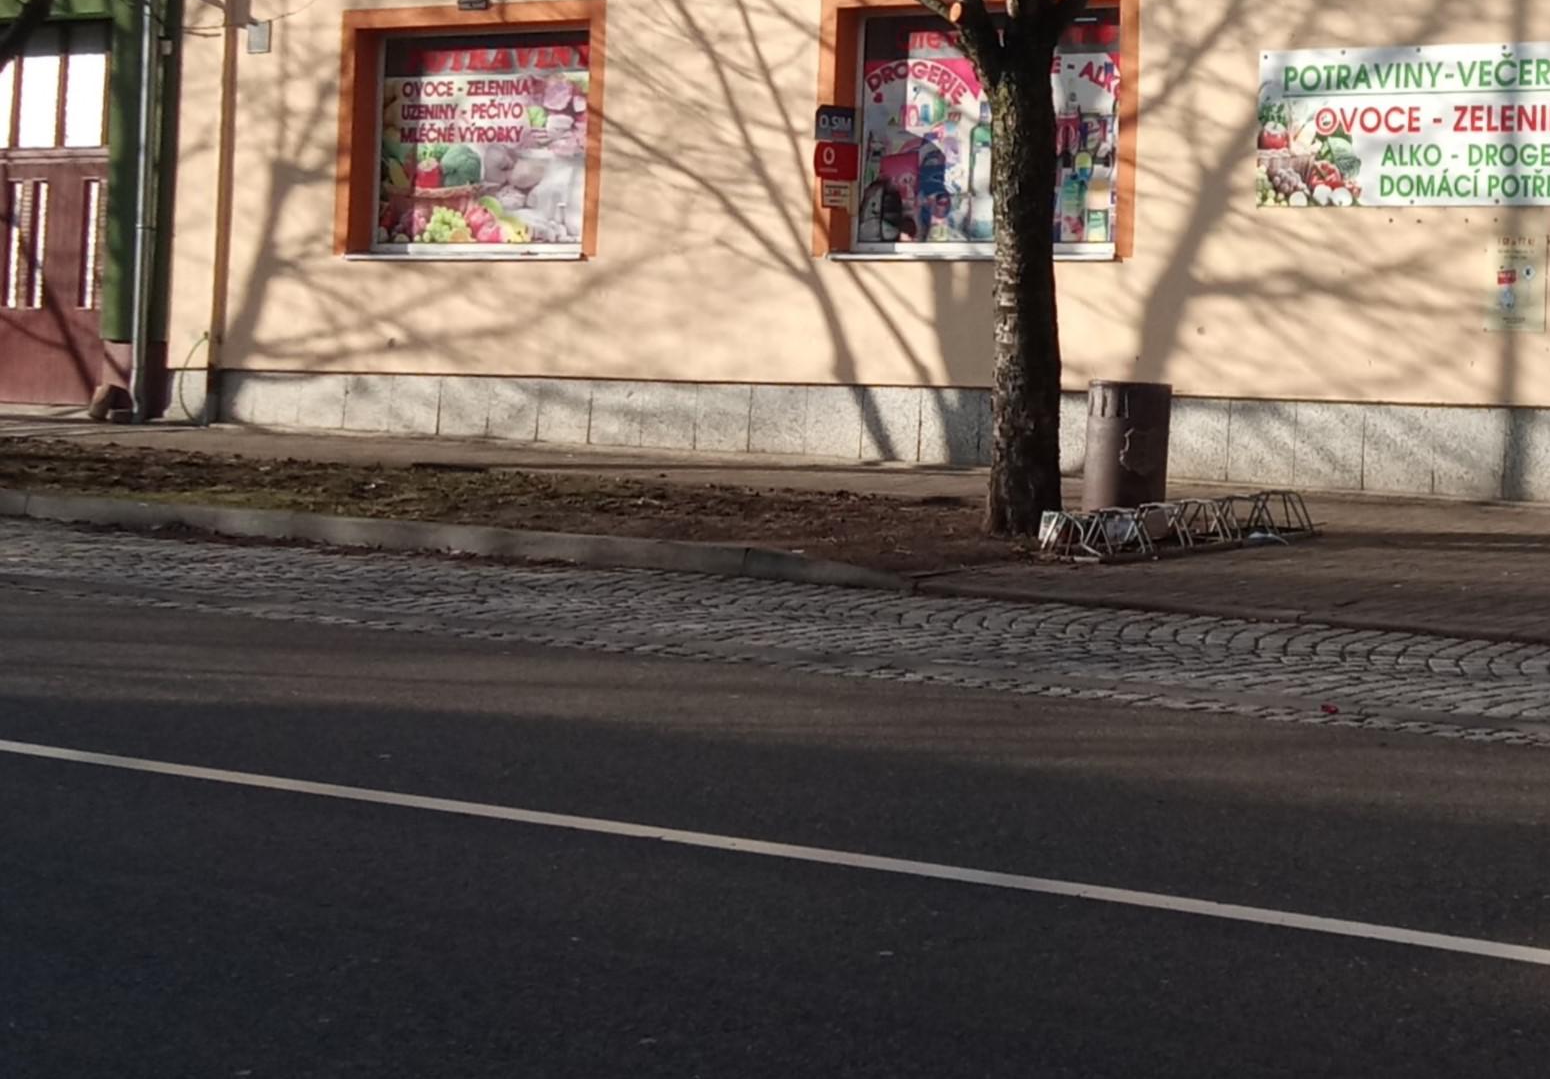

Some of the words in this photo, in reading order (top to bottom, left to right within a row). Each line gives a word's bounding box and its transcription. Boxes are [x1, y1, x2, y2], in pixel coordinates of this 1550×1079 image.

[402, 80, 454, 98] OVOCE
[466, 79, 532, 97] ZELENINA
[866, 61, 967, 105] DROGERIE
[401, 104, 458, 120] UZENINY
[470, 100, 523, 120] PEČIVO
[1315, 106, 1421, 135] OVOCE
[401, 124, 455, 143] MLÉČNÉ
[458, 122, 523, 143] VÝROBKY
[1381, 143, 1442, 167] ALKO
[1379, 168, 1480, 198] DOMÁCÍ
